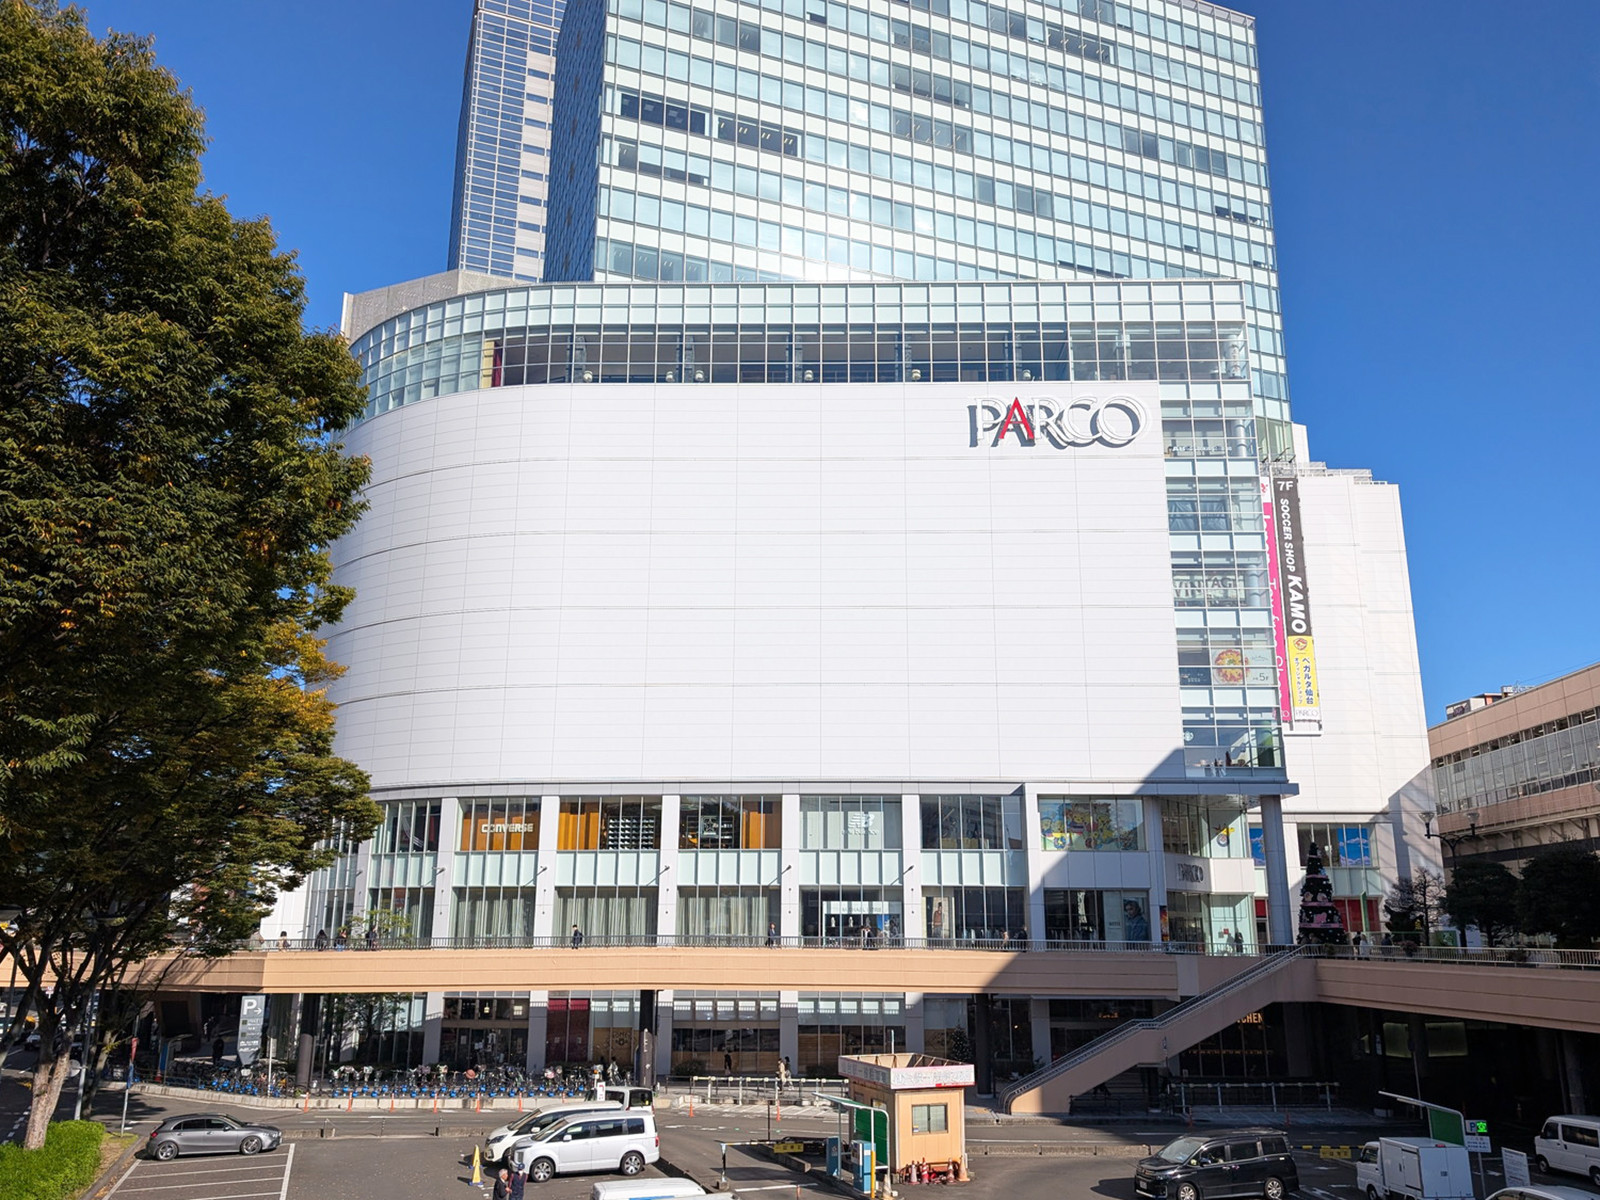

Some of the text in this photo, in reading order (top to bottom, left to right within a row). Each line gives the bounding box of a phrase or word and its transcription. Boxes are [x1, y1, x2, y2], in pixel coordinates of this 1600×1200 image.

[972, 395, 1147, 445] PARCO
[1277, 480, 1294, 491] 7F
[1280, 498, 1307, 634] SOCCER SHOP KAMO
[1173, 577, 1239, 597] VINTAG
[1302, 657, 1314, 705] ベガルタ仙台
[481, 823, 534, 833] CONVERSE
[243, 999, 257, 1015] P
[1469, 1122, 1476, 1132] P
